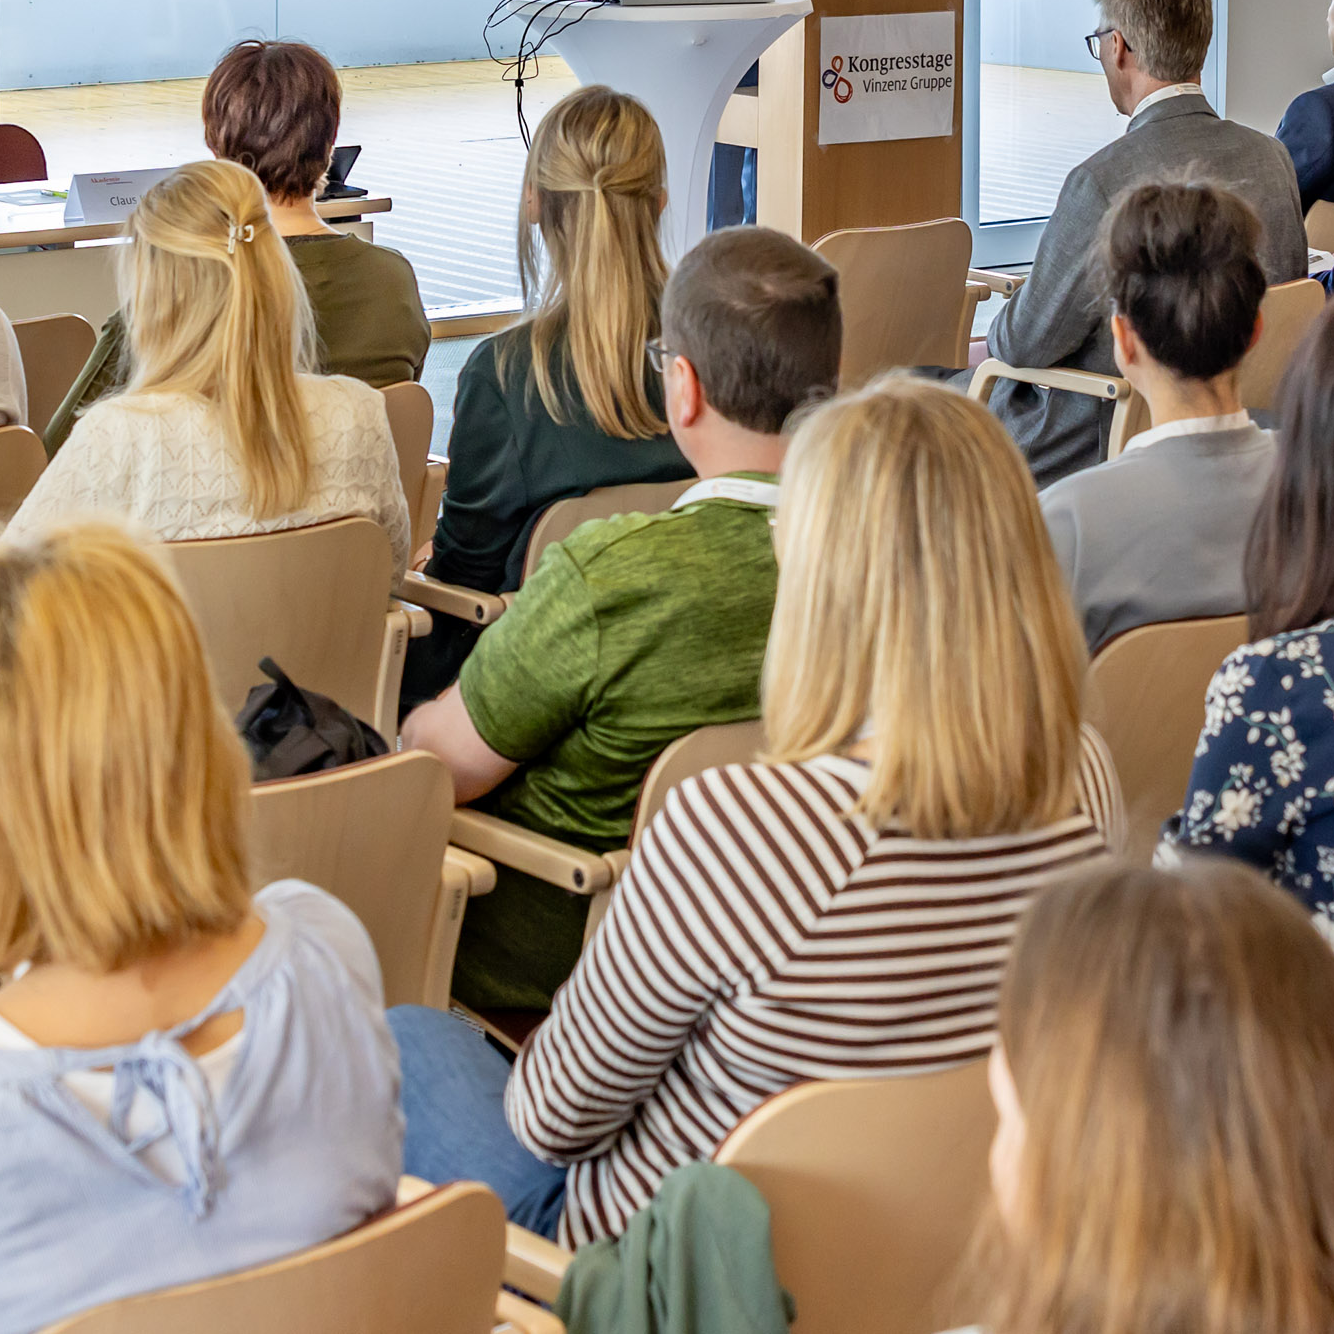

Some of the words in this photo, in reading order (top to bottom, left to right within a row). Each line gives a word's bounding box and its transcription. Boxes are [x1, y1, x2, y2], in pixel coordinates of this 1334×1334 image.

[847, 52, 954, 76] Kongresstage
[862, 77, 908, 93] Vinzenz
[910, 76, 953, 92] Gruppe
[109, 195, 138, 207] Claus
